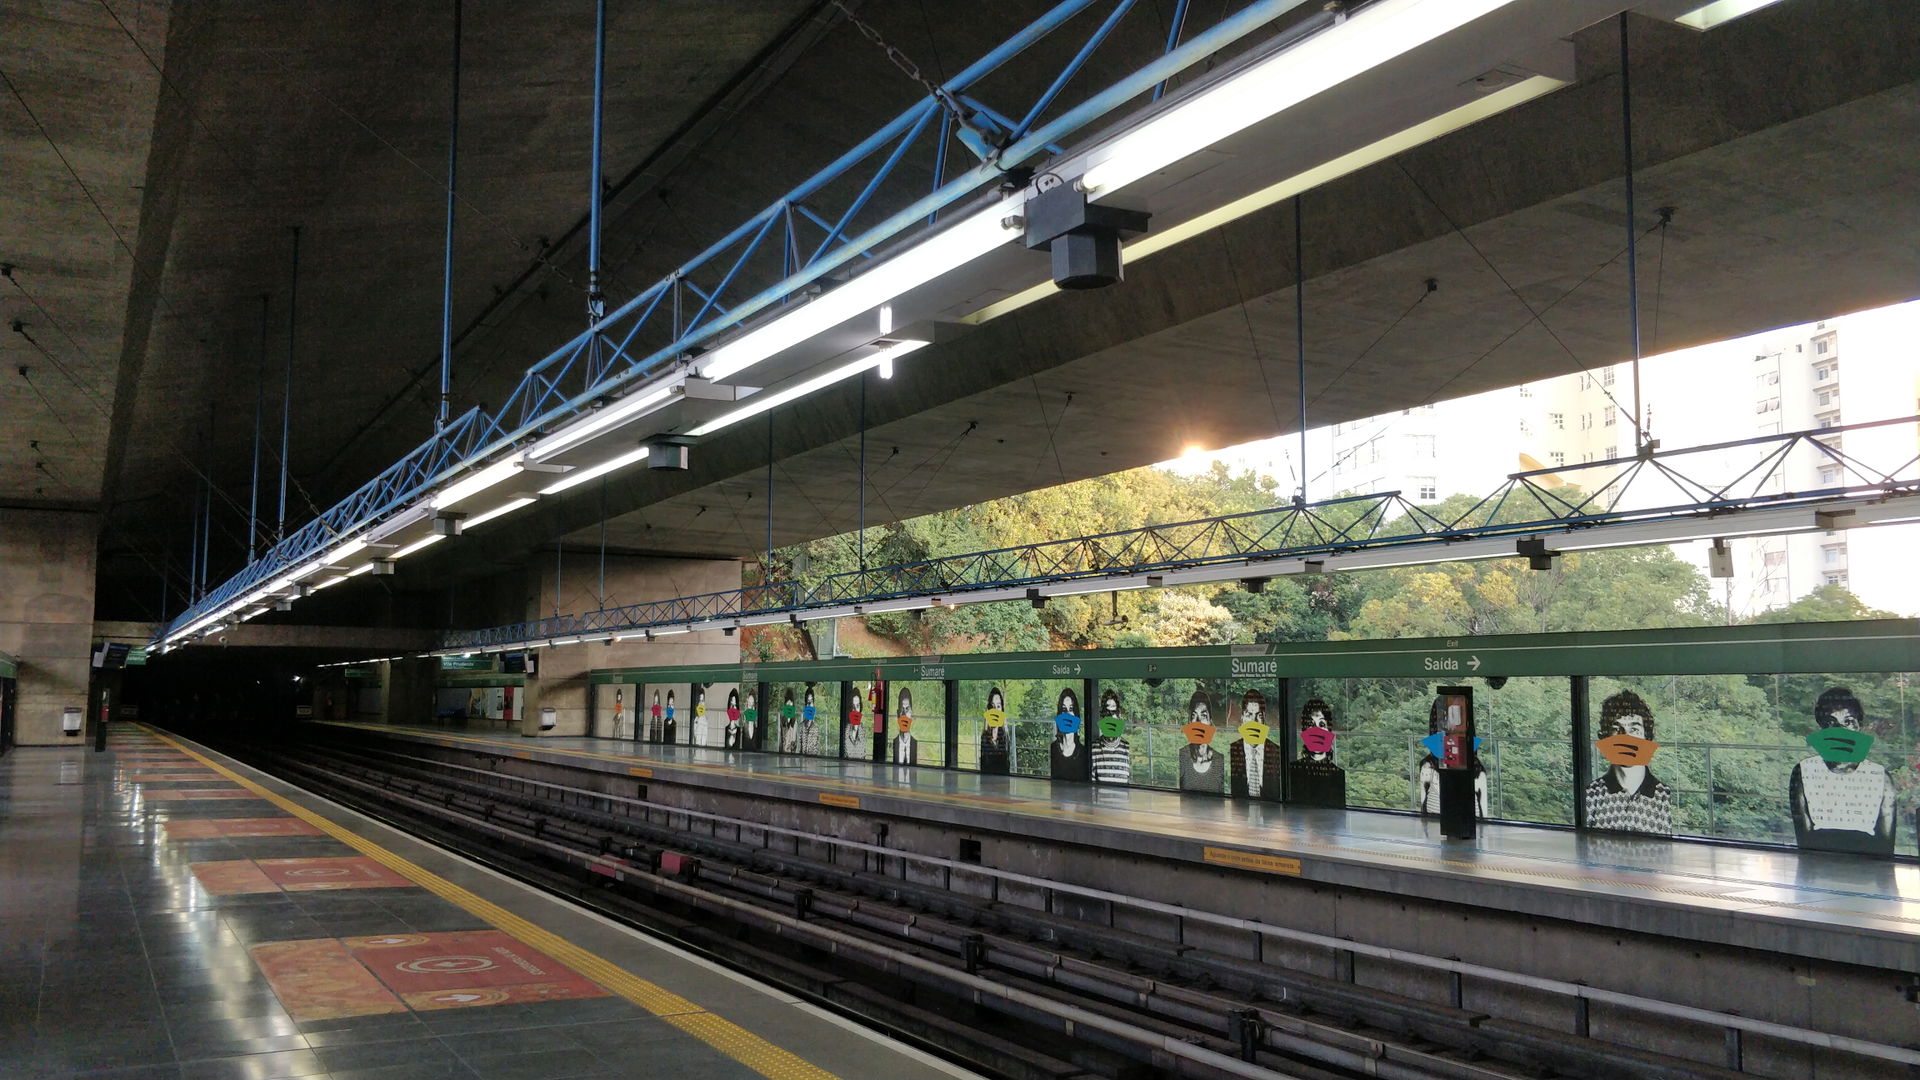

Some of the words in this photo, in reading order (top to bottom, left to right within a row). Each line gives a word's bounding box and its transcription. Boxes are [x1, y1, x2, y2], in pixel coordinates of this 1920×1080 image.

[920, 665, 945, 677] Sumaré
[1231, 657, 1278, 673] Sumaré
[1424, 656, 1459, 671] Saída
